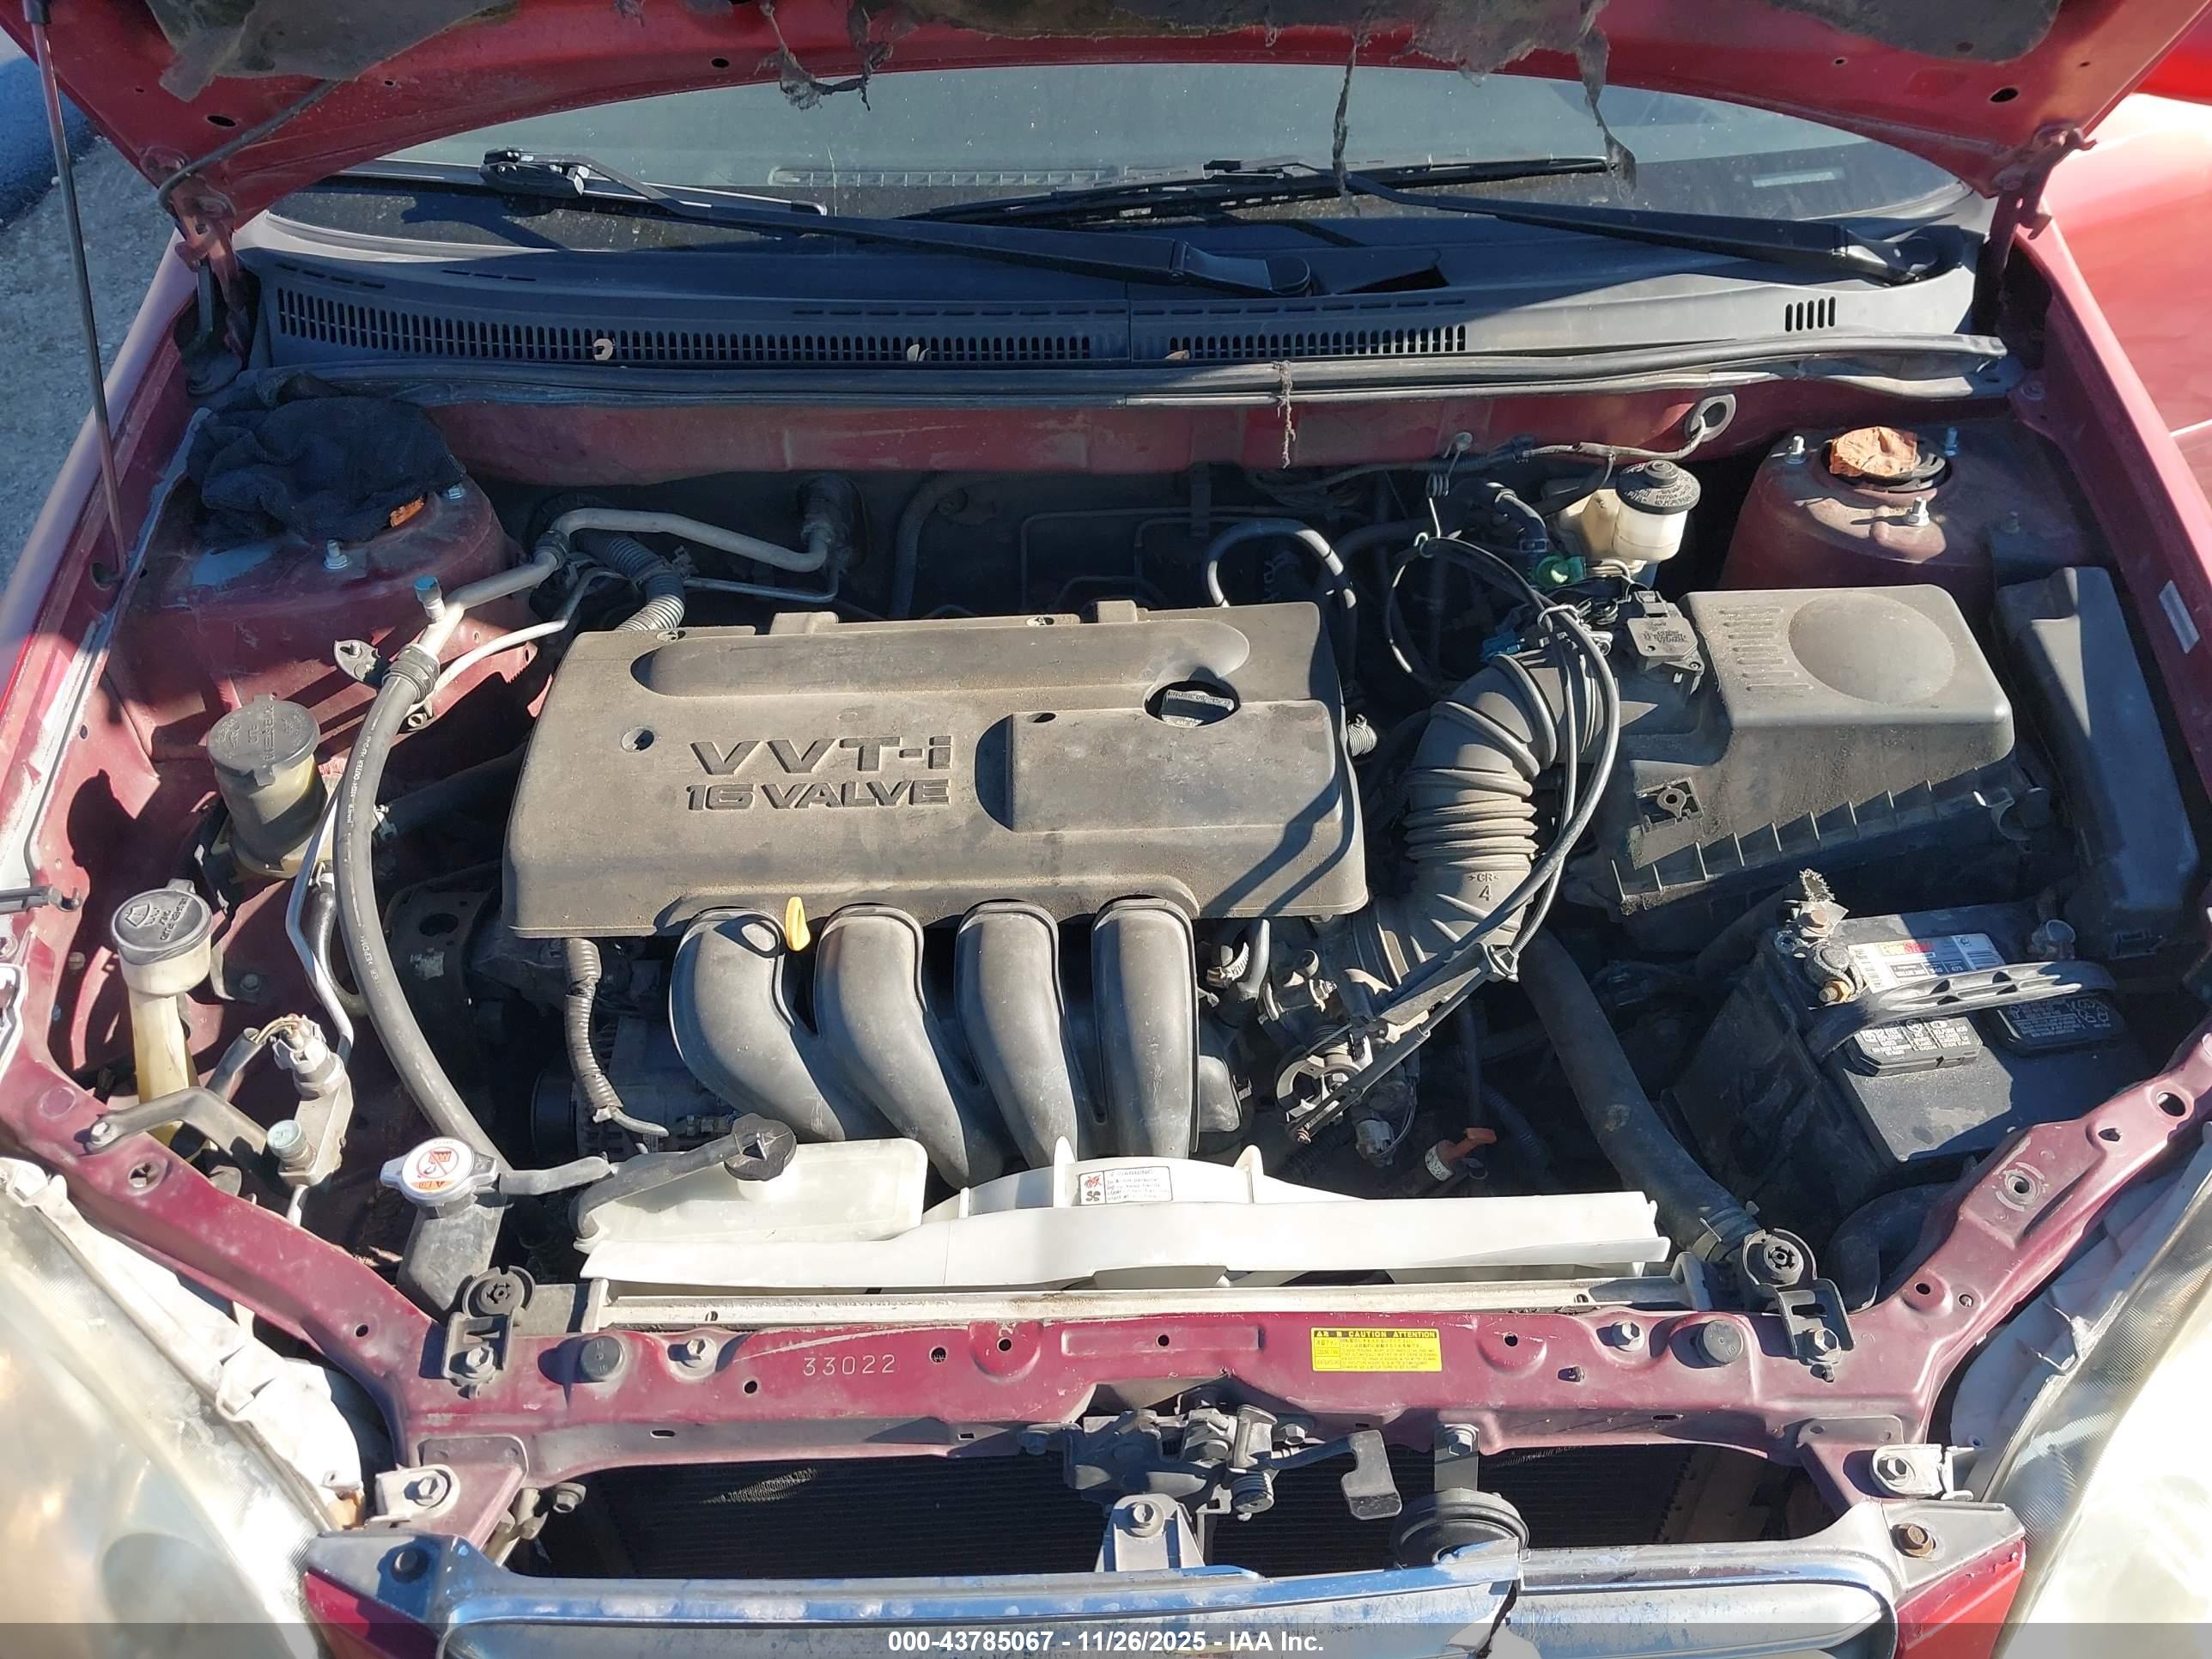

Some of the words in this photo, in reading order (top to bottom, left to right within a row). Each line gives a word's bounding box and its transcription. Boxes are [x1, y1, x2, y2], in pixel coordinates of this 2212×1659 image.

[690, 735, 952, 775] VVT-i
[687, 782, 756, 811] 16
[762, 778, 951, 811] VALVE
[1478, 884, 1492, 902] 4
[803, 1354, 895, 1376] 33022
